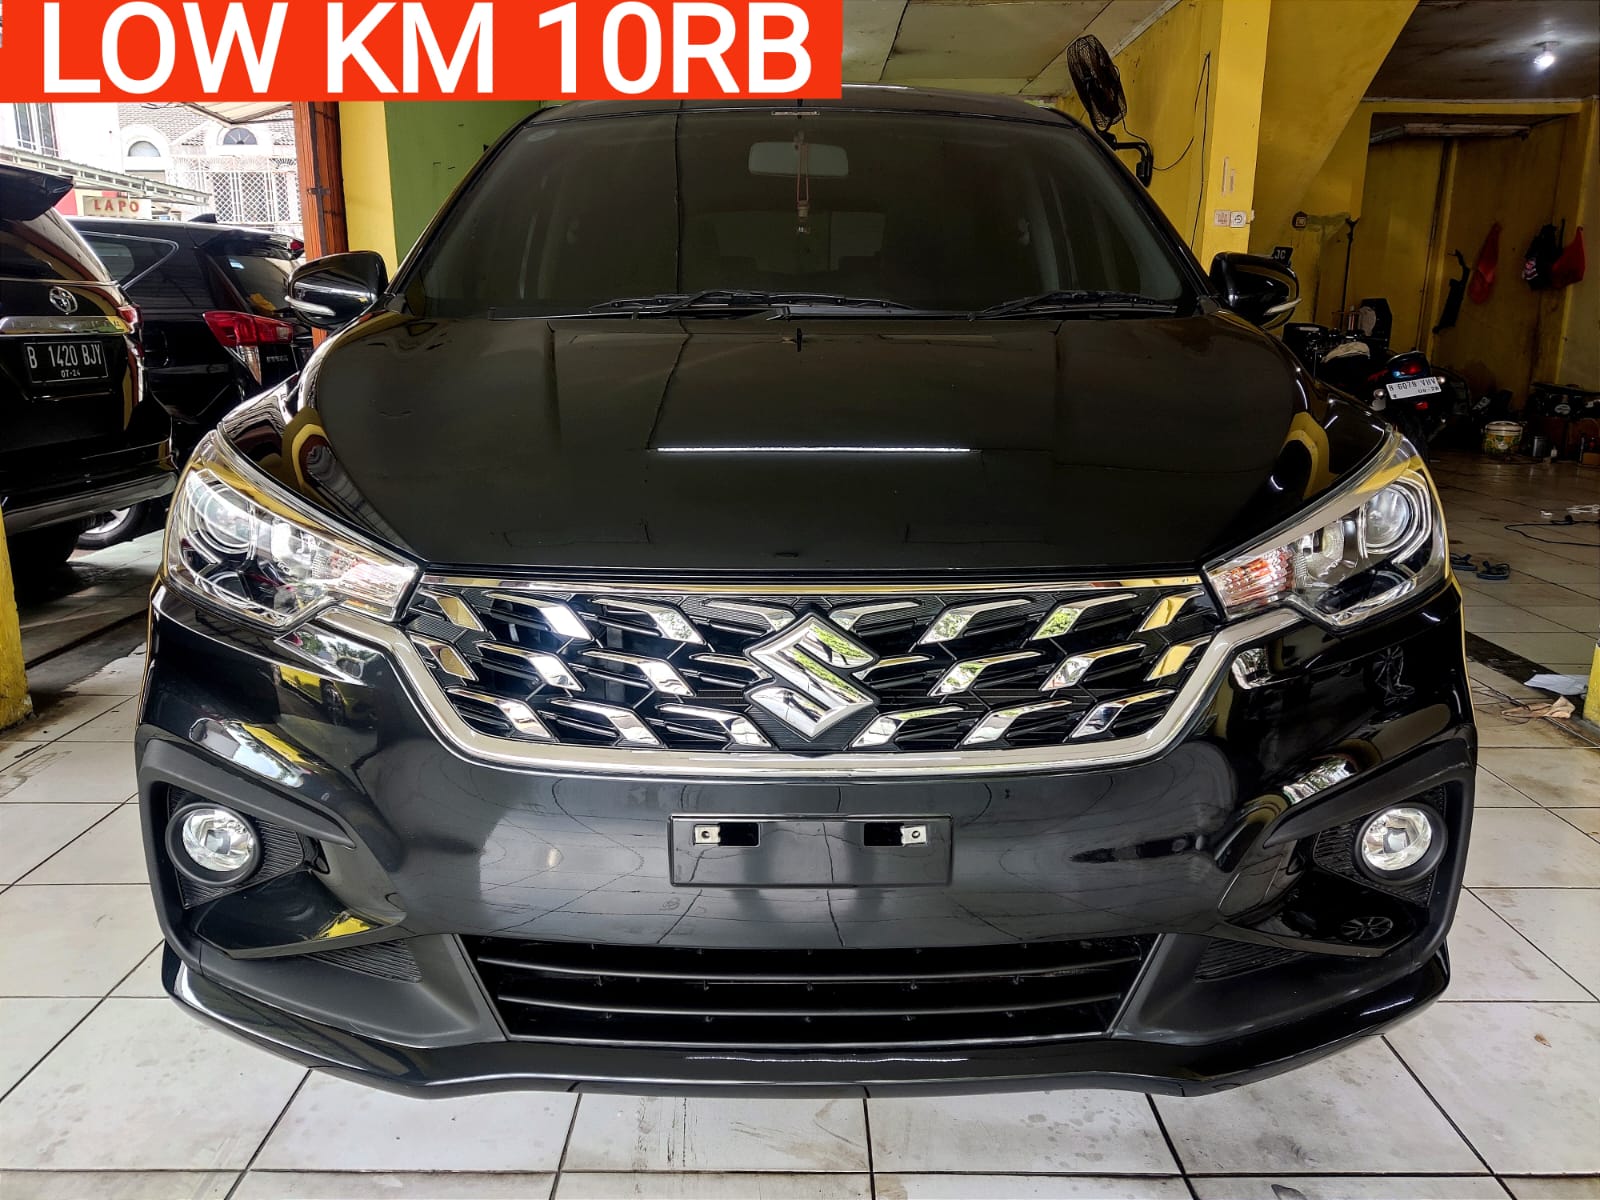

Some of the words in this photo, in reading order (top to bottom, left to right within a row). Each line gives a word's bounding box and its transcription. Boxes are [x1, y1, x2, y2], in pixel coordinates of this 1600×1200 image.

[94, 199, 140, 213] LAPO
[26, 346, 38, 369] B
[48, 345, 79, 367] 1420
[81, 344, 102, 366] BJY
